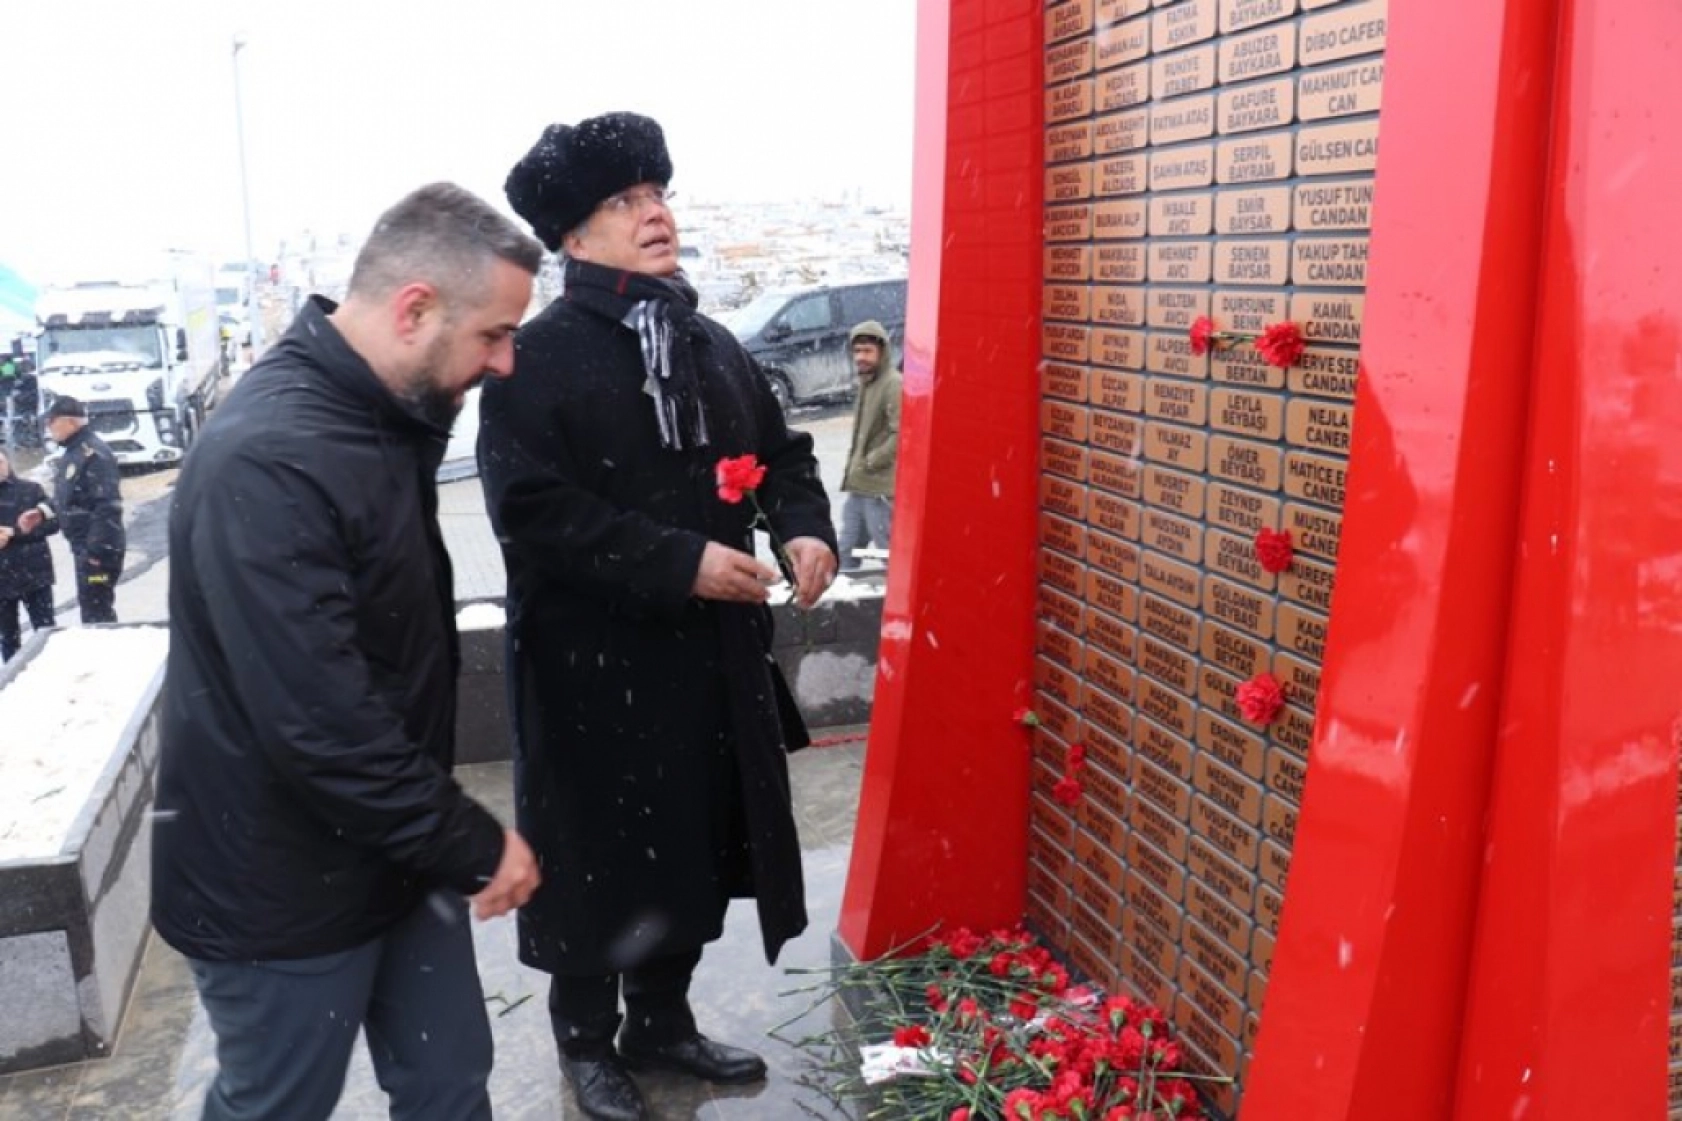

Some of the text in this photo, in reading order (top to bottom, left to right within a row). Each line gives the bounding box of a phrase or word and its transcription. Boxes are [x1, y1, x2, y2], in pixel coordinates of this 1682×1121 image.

[1337, 15, 1386, 45] CAFER
[1301, 68, 1358, 97] MAHMUT
[1327, 92, 1357, 114] CAN
[1298, 137, 1351, 166] GÜLŞEN
[1297, 188, 1342, 206] YUSUF
[1310, 206, 1367, 225] CANDAN
[1296, 245, 1339, 261] YAKUP
[1307, 263, 1363, 281] CANDAN
[1312, 298, 1356, 320] KAMİL
[1305, 319, 1361, 340] CANDAN
[1307, 407, 1349, 429] NEJLA
[1305, 425, 1349, 449] CANER
[1288, 457, 1333, 485] HATİCE
